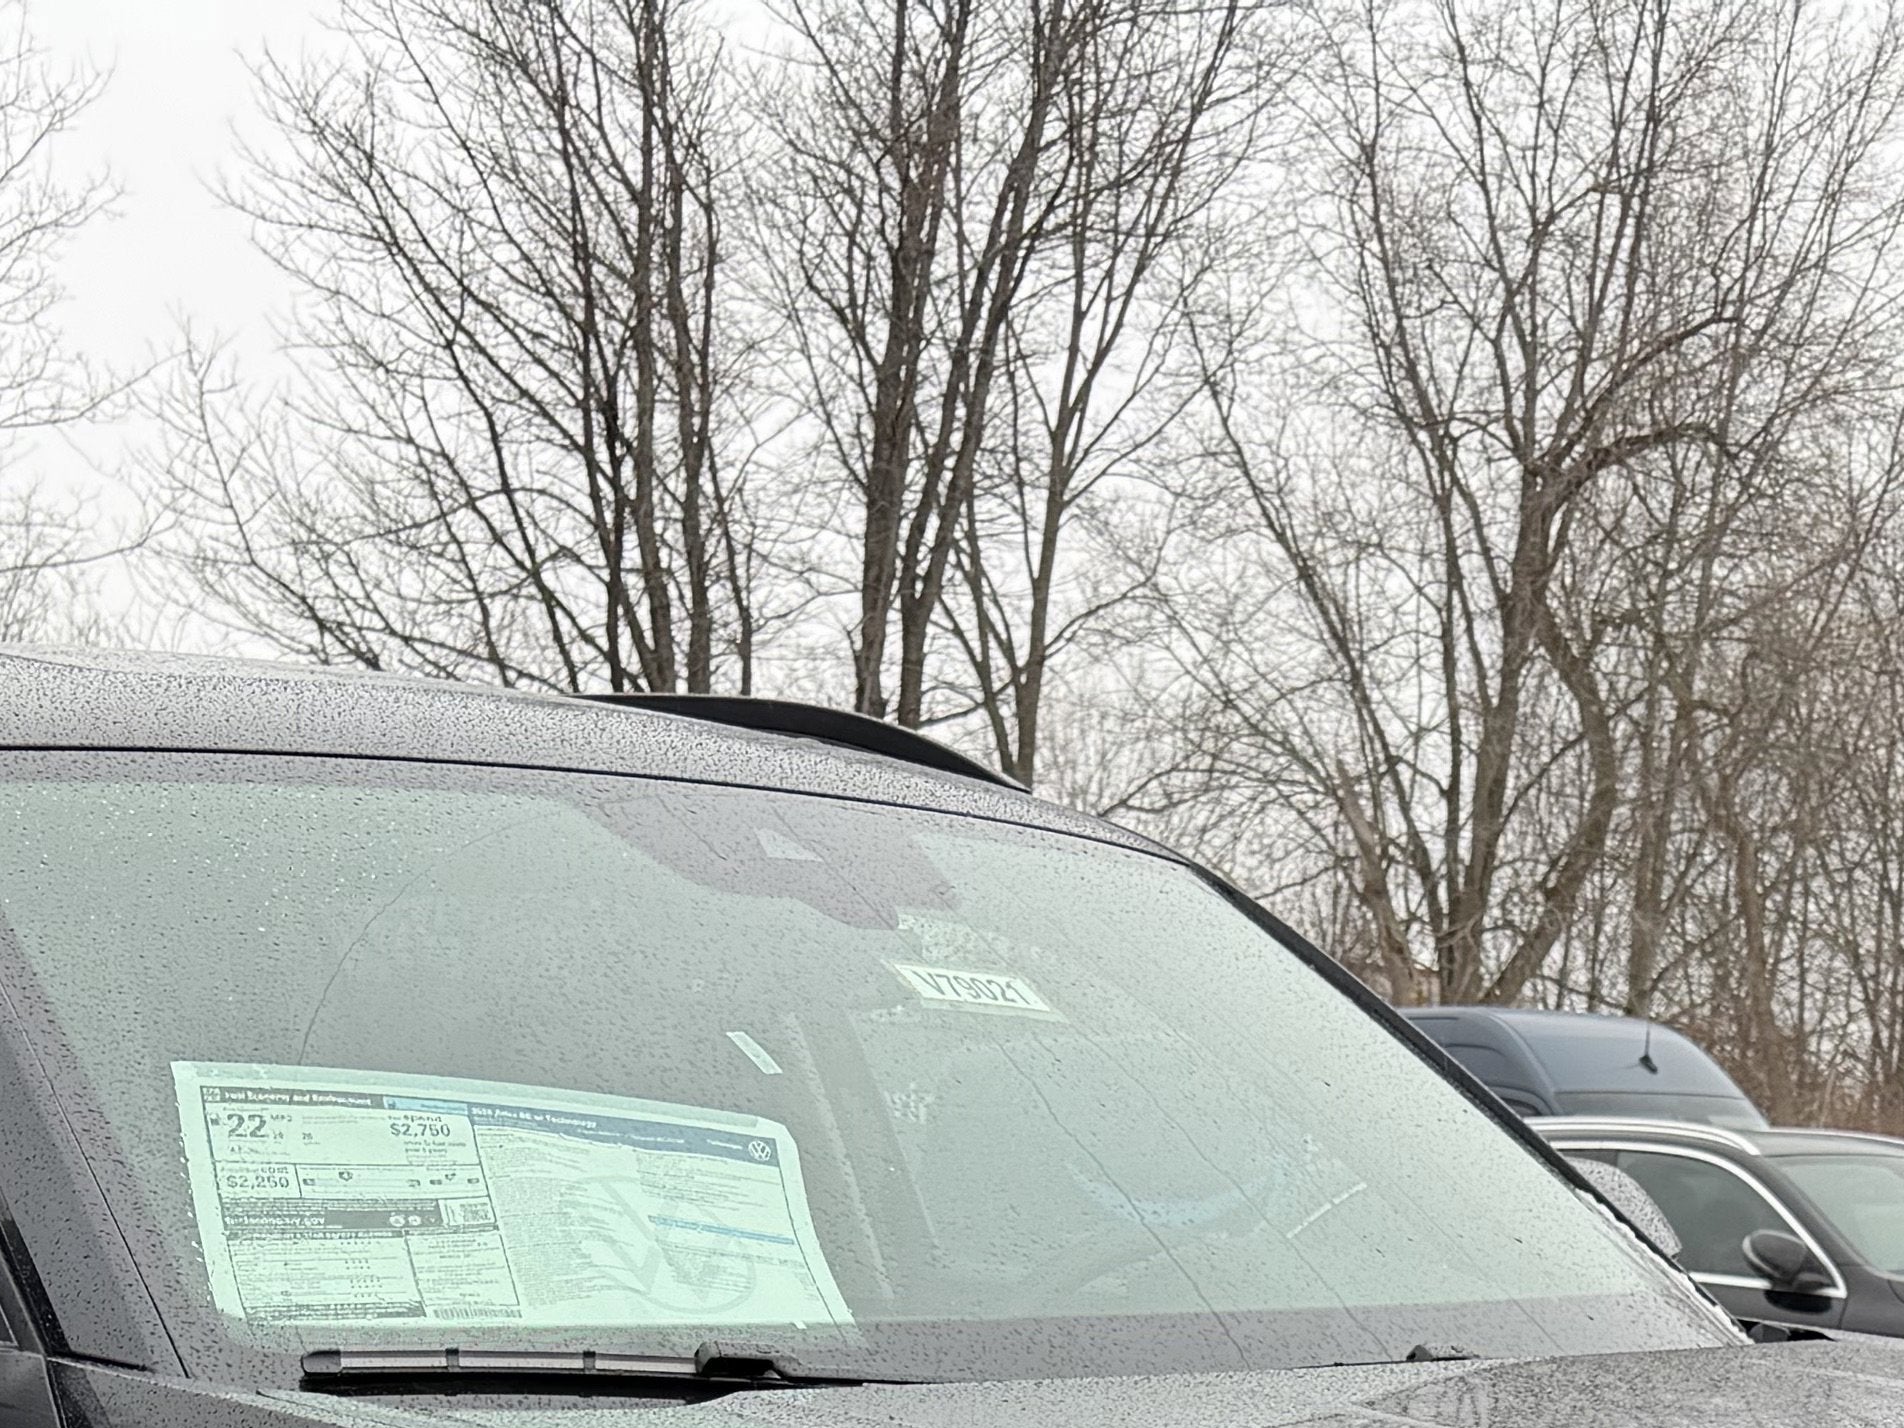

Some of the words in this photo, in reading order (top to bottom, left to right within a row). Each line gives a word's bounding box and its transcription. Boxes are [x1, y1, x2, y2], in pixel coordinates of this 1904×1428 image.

[911, 969, 1031, 1005] V79021
[226, 1113, 270, 1138] 22
[390, 1122, 451, 1138] $2,750
[226, 1174, 290, 1190] $2,250
